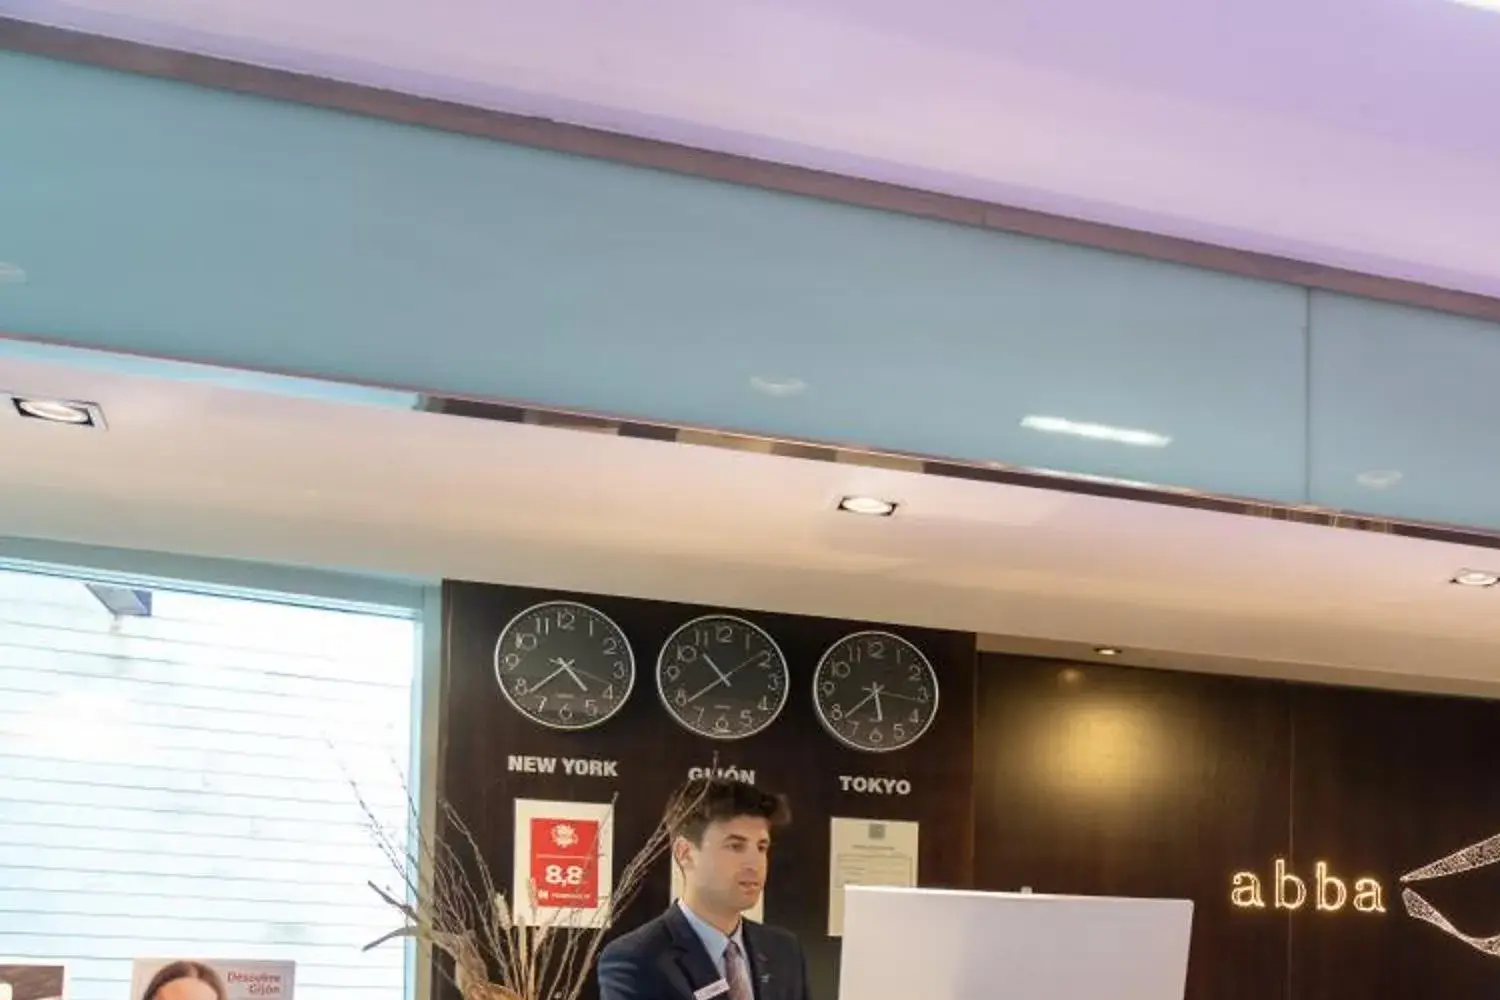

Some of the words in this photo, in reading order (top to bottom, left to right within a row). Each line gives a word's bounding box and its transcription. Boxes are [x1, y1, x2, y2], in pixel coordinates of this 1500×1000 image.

[535, 617, 549, 636] 11
[557, 610, 575, 631] 12
[515, 632, 537, 651] 10
[695, 628, 709, 648] 11
[715, 625, 733, 643] 12
[602, 637, 617, 655] 2
[677, 643, 697, 662] 10
[847, 645, 861, 663] 11
[505, 653, 520, 671] 9
[613, 661, 625, 679] 3
[831, 660, 851, 679] 10
[667, 665, 680, 682] 9
[909, 664, 921, 681] 2
[515, 678, 528, 696] 8
[767, 673, 779, 691] 3
[822, 681, 835, 697] 9
[602, 684, 614, 700] 4
[675, 687, 688, 706] 8
[535, 696, 548, 713] 7
[559, 703, 573, 721] 6
[585, 699, 598, 716] 5
[757, 695, 770, 711] 4
[831, 703, 843, 721] 8
[715, 712, 729, 731] 6
[740, 709, 753, 728] 5
[909, 708, 920, 723] 4
[847, 719, 860, 737] 7
[869, 727, 883, 742] 6
[893, 723, 905, 739] 5
[507, 755, 557, 773] NEW
[561, 757, 619, 777] YORK
[838, 775, 912, 795] TOKYO
[544, 864, 584, 888] 8,8
[1231, 858, 1387, 912] abba
